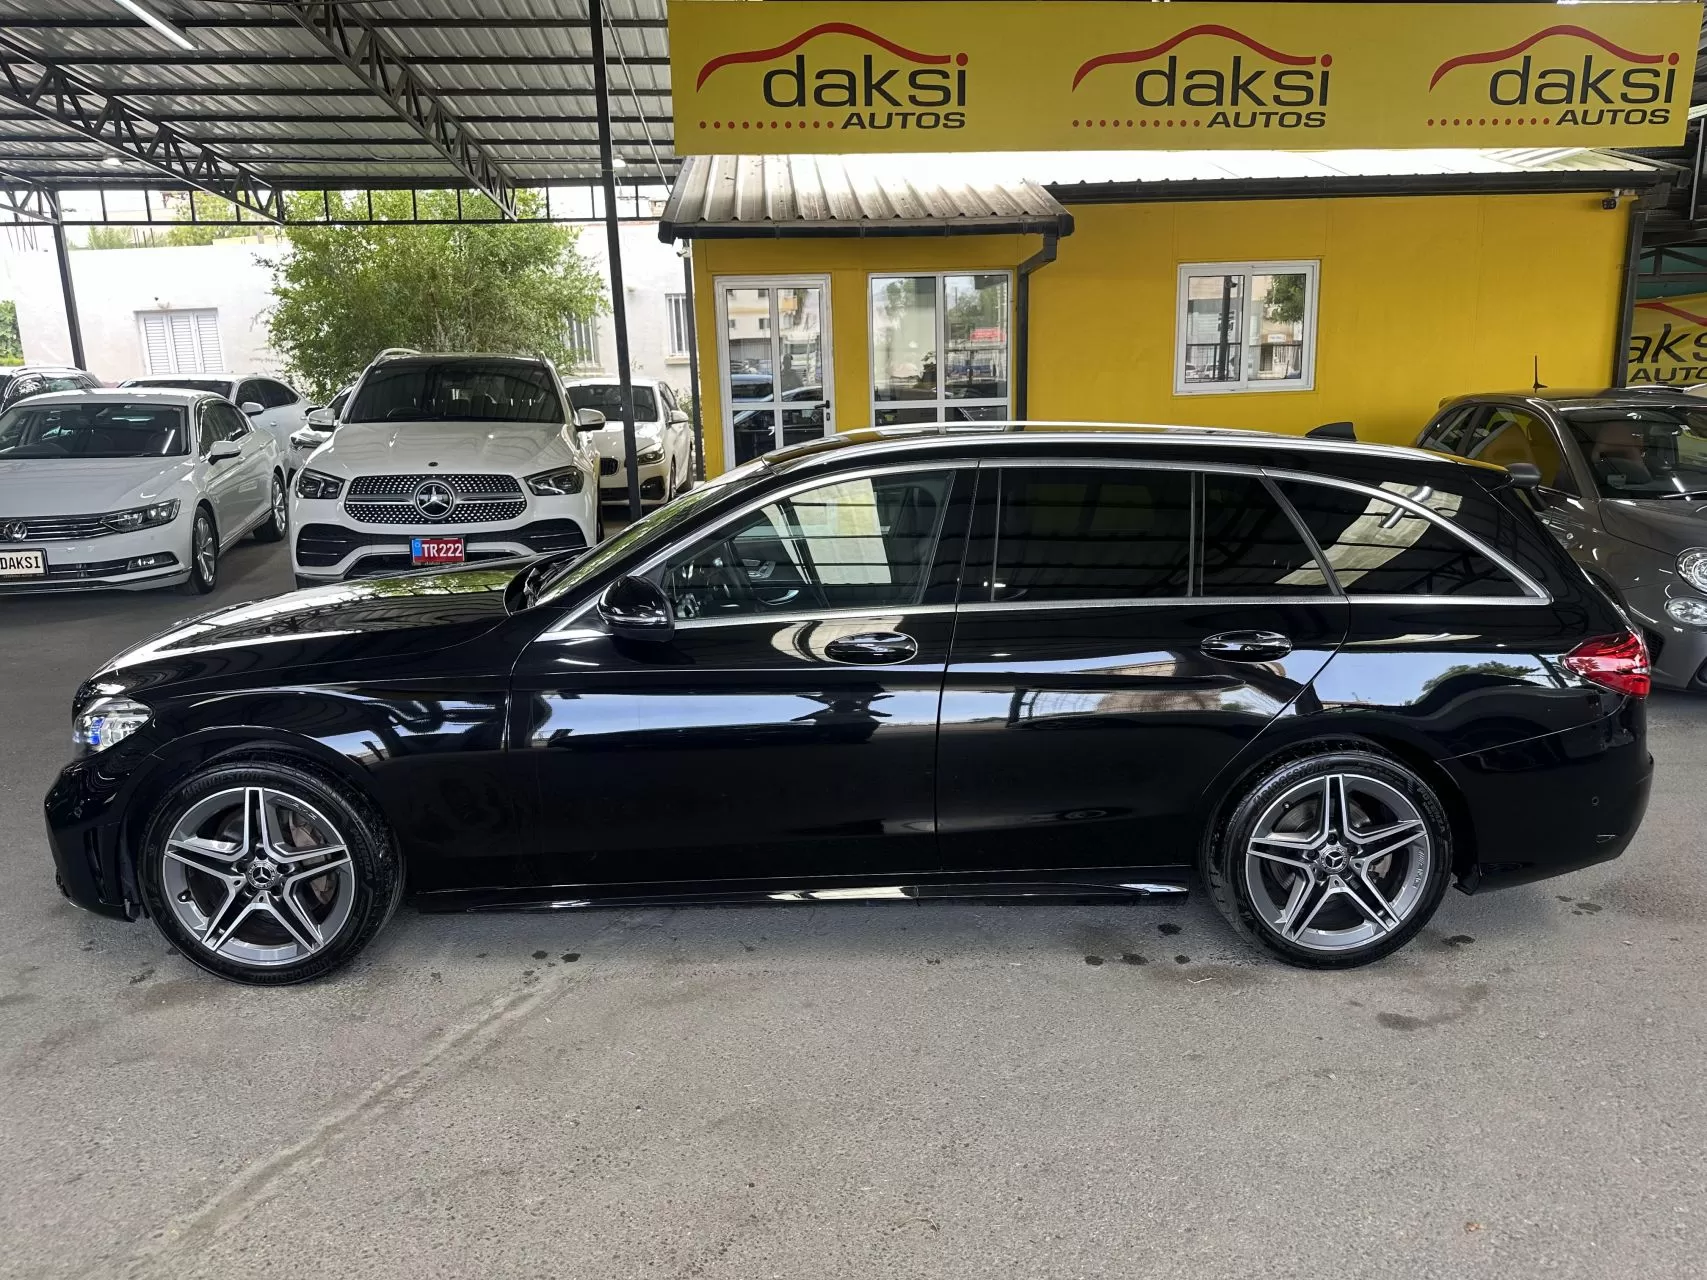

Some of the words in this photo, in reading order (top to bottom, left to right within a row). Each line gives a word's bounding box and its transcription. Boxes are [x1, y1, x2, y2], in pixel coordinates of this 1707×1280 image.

[763, 53, 968, 107] daksi
[1135, 54, 1332, 106] daksi
[1489, 53, 1679, 105] daksi
[841, 112, 966, 129] AUTOS
[1207, 111, 1326, 128] AUTOS
[1556, 109, 1669, 125] AUTOS
[422, 543, 463, 557] TR222
[0, 556, 41, 570] DAKSI
